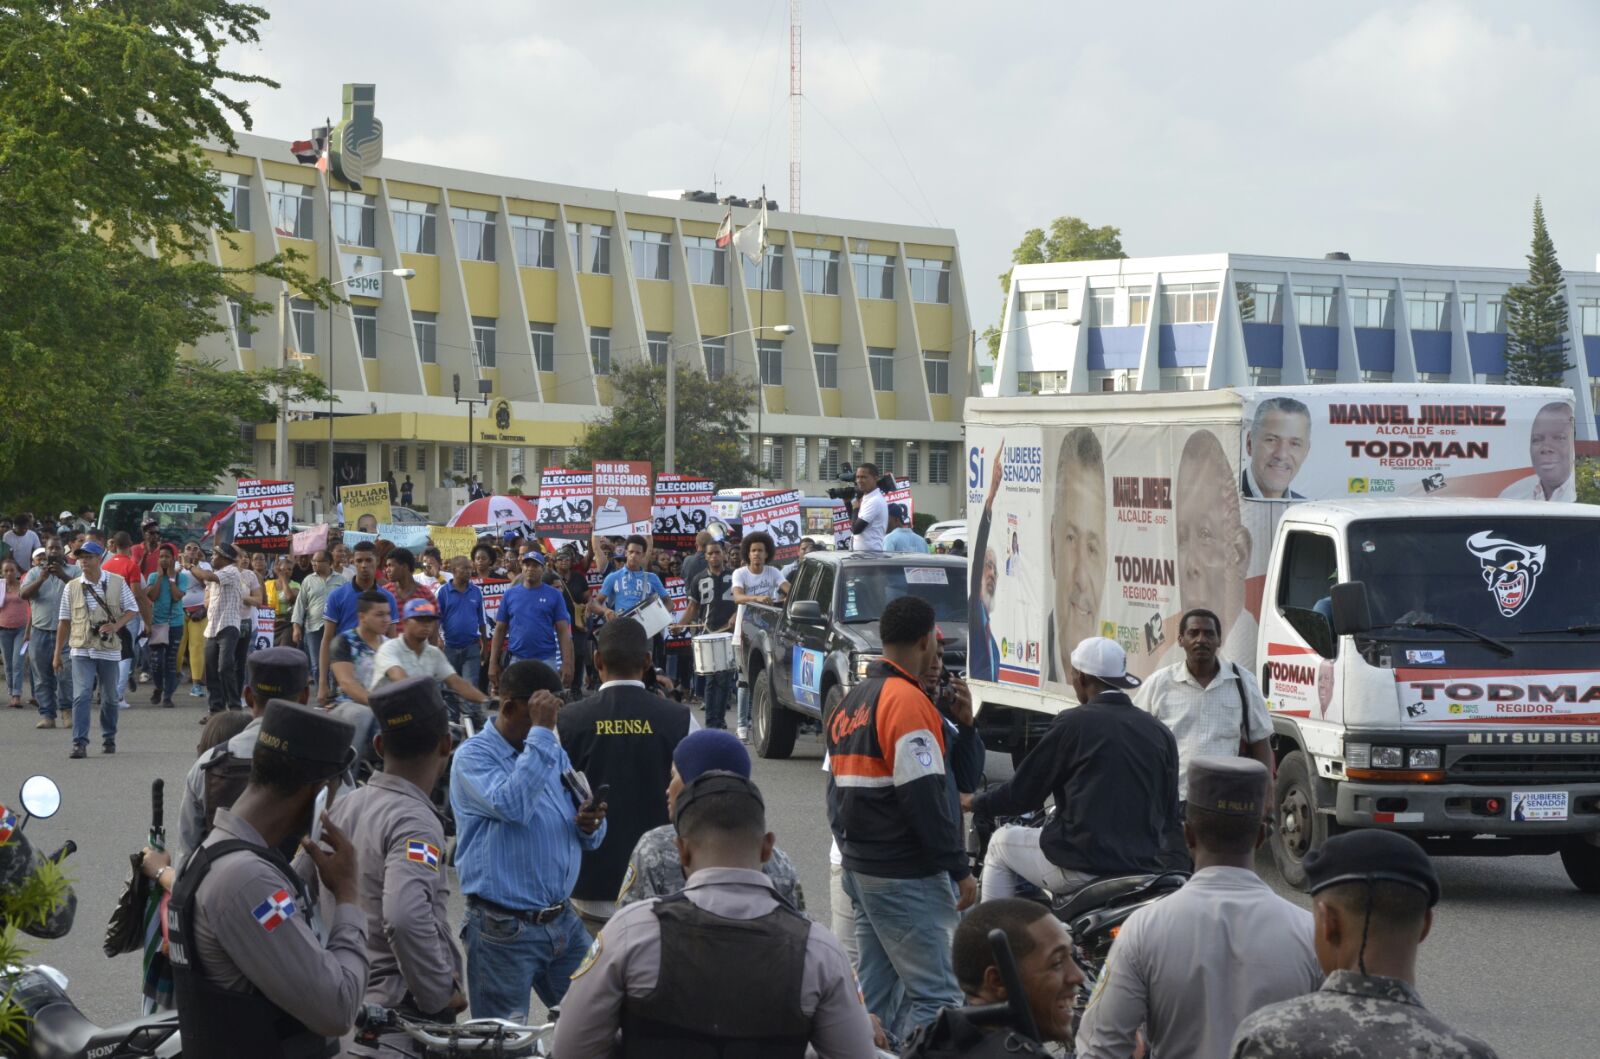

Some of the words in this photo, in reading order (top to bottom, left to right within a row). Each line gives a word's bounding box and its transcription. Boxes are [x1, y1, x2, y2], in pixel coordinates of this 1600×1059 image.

[348, 276, 379, 293] espre
[1328, 404, 1414, 425] MANUEL
[1418, 405, 1506, 426] JIMENEZ
[1376, 426, 1434, 435] ALCALDE
[1004, 447, 1041, 464] HUBIERES
[1345, 440, 1489, 459] TODMAN
[596, 464, 613, 473] POR
[614, 464, 630, 473] LOS
[1379, 458, 1433, 467] REGIDOR
[595, 474, 647, 485] DERECHOS
[1004, 465, 1041, 483] SENADOR
[237, 484, 295, 497] ELECCIONES
[595, 486, 651, 496] ELECTORALES
[656, 482, 714, 491] ELECCIONES
[1113, 477, 1141, 508] MANUEL
[344, 487, 388, 499] JULIAN
[262, 498, 293, 507] FRAUDE
[344, 494, 388, 505] POLANCO
[656, 497, 666, 505] NO
[742, 492, 800, 511] ELECCIONES
[151, 502, 198, 513] AMET
[756, 513, 767, 521] AL
[768, 506, 800, 518] FRAUDE
[1118, 510, 1153, 523] ALCALDE
[1115, 556, 1175, 586] TODMAN
[1123, 586, 1158, 601] REGIDOR
[1118, 626, 1140, 640] FRENTE
[1268, 661, 1315, 686] TODMAN
[1275, 683, 1297, 693] REGIDOR
[1496, 704, 1554, 714] REGIDOR
[596, 720, 653, 735] PRENSA
[1468, 733, 1599, 743] MITSUBISH
[1527, 793, 1567, 801] HUBIERES
[1527, 799, 1566, 807] SENADOR
